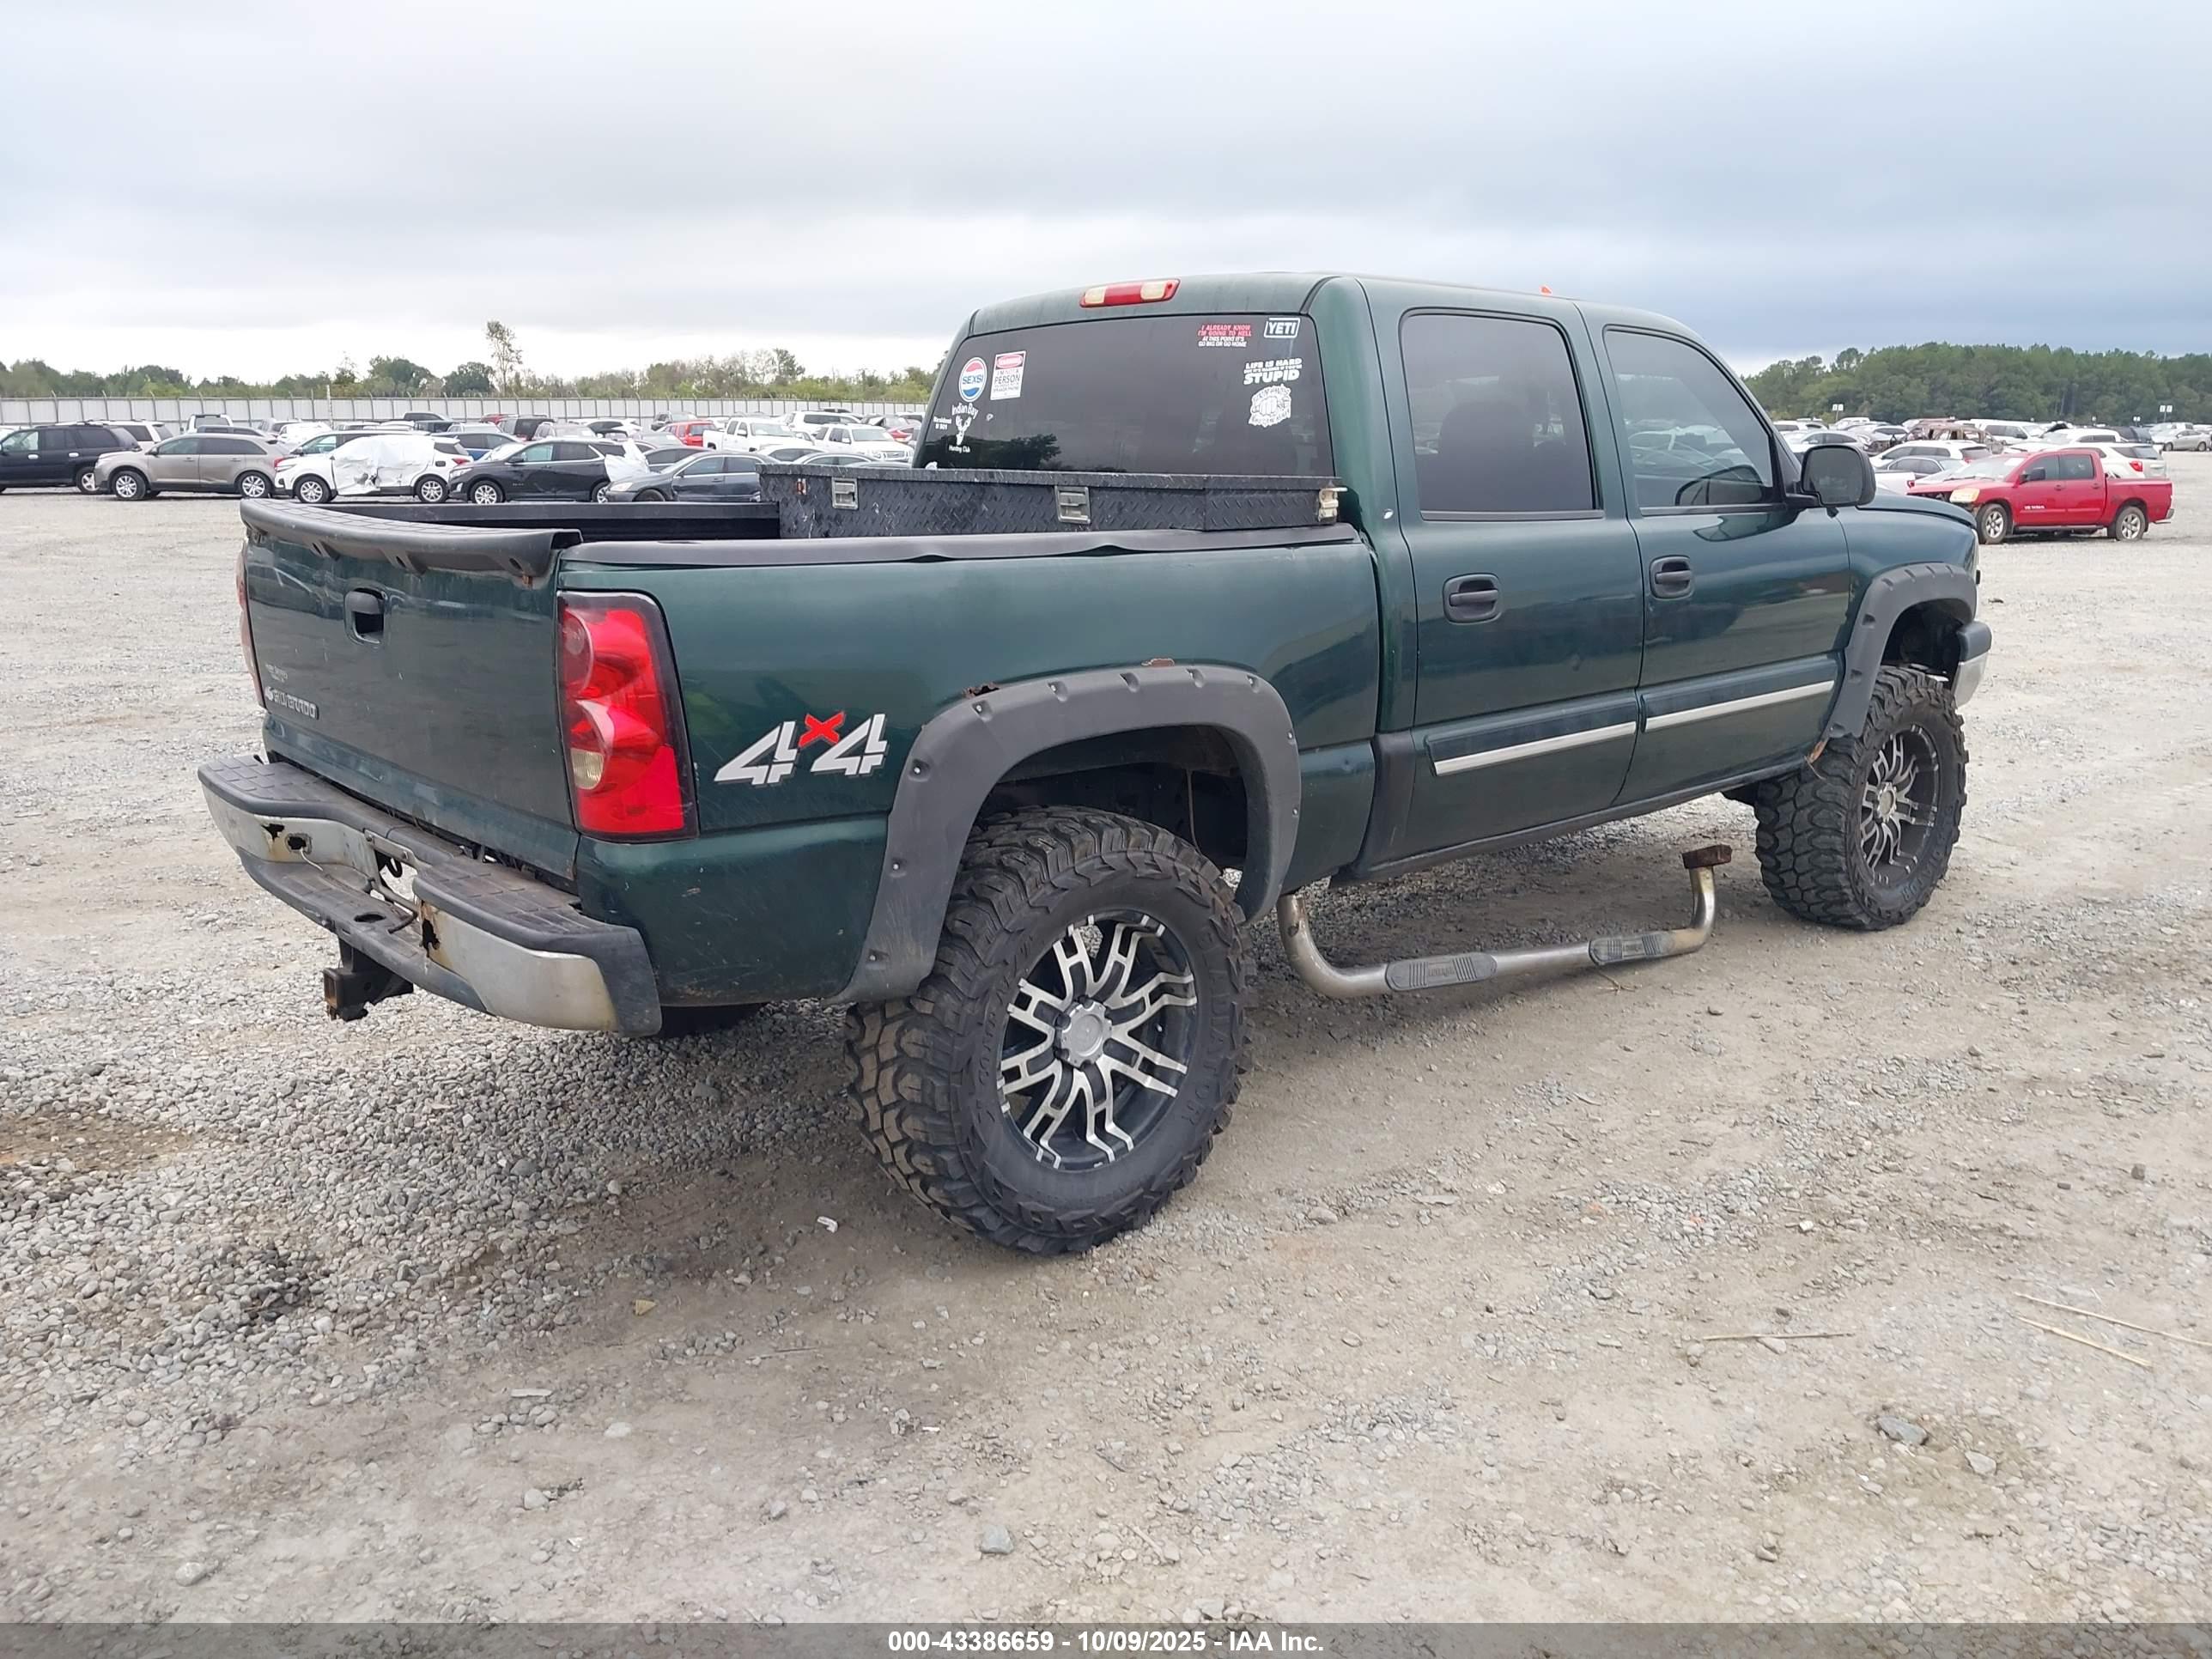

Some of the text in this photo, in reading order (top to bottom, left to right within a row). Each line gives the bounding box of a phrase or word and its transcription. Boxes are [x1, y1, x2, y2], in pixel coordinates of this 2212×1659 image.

[1268, 322, 1297, 334] YETI
[1275, 358, 1303, 367] HARD
[962, 374, 983, 385] SEXSI
[994, 374, 1020, 385] PERSON
[1243, 369, 1300, 385] STUPID
[951, 403, 979, 419] Indian Bay
